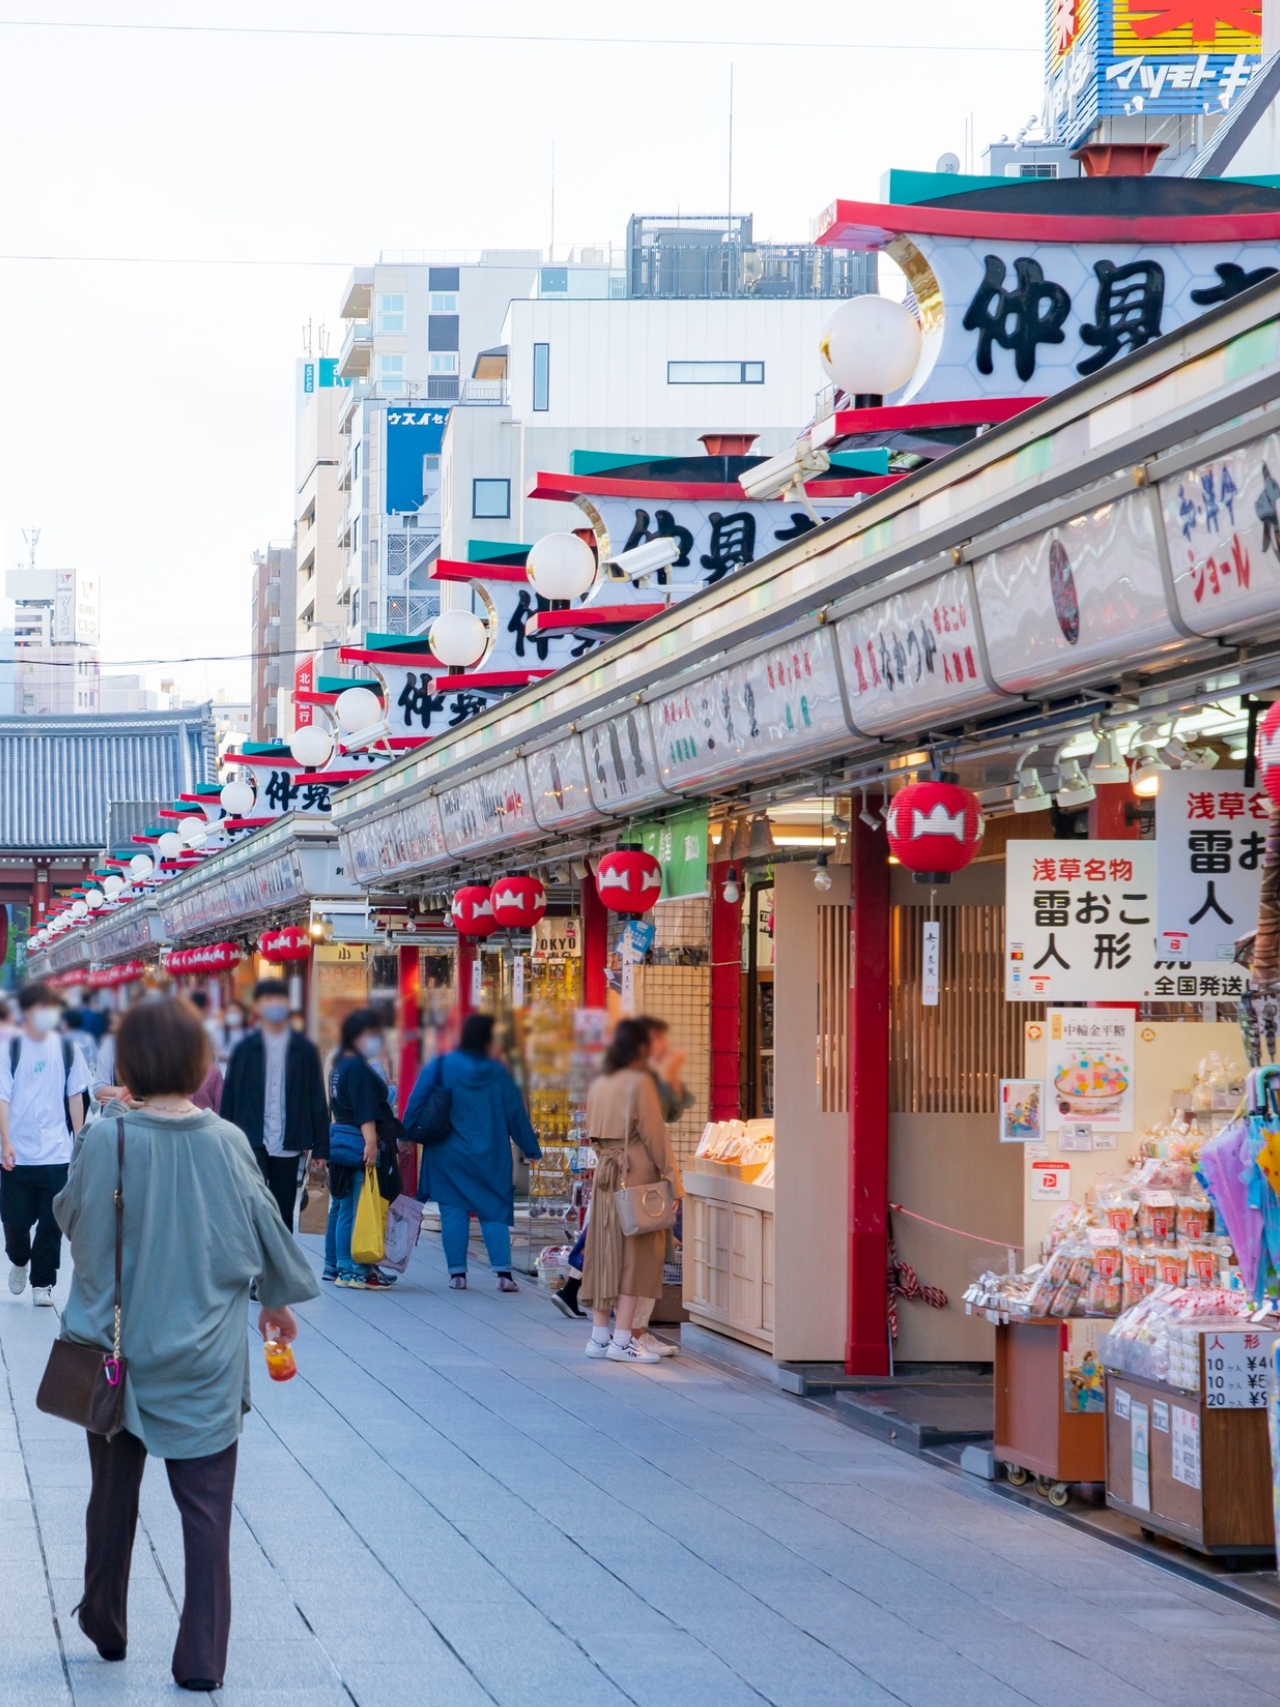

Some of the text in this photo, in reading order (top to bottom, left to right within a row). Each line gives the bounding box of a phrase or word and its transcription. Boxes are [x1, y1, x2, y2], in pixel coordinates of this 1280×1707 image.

[1106, 54, 1261, 98] マツモトキ
[963, 254, 1280, 381] 仲見
[388, 412, 448, 425] ウスイセ
[620, 508, 823, 589] 仲見
[1187, 532, 1251, 603] ショール
[299, 672, 310, 722] 北行
[1032, 857, 1134, 883] 浅草名物
[1033, 890, 1151, 927] 雷おこ
[535, 938, 576, 951] OKYO
[1154, 975, 1254, 997] 全国発送
[1207, 1357, 1224, 1372] 10
[1246, 1356, 1273, 1372] ¥4
[1208, 1375, 1224, 1390] 10
[1207, 1392, 1226, 1407] 20
